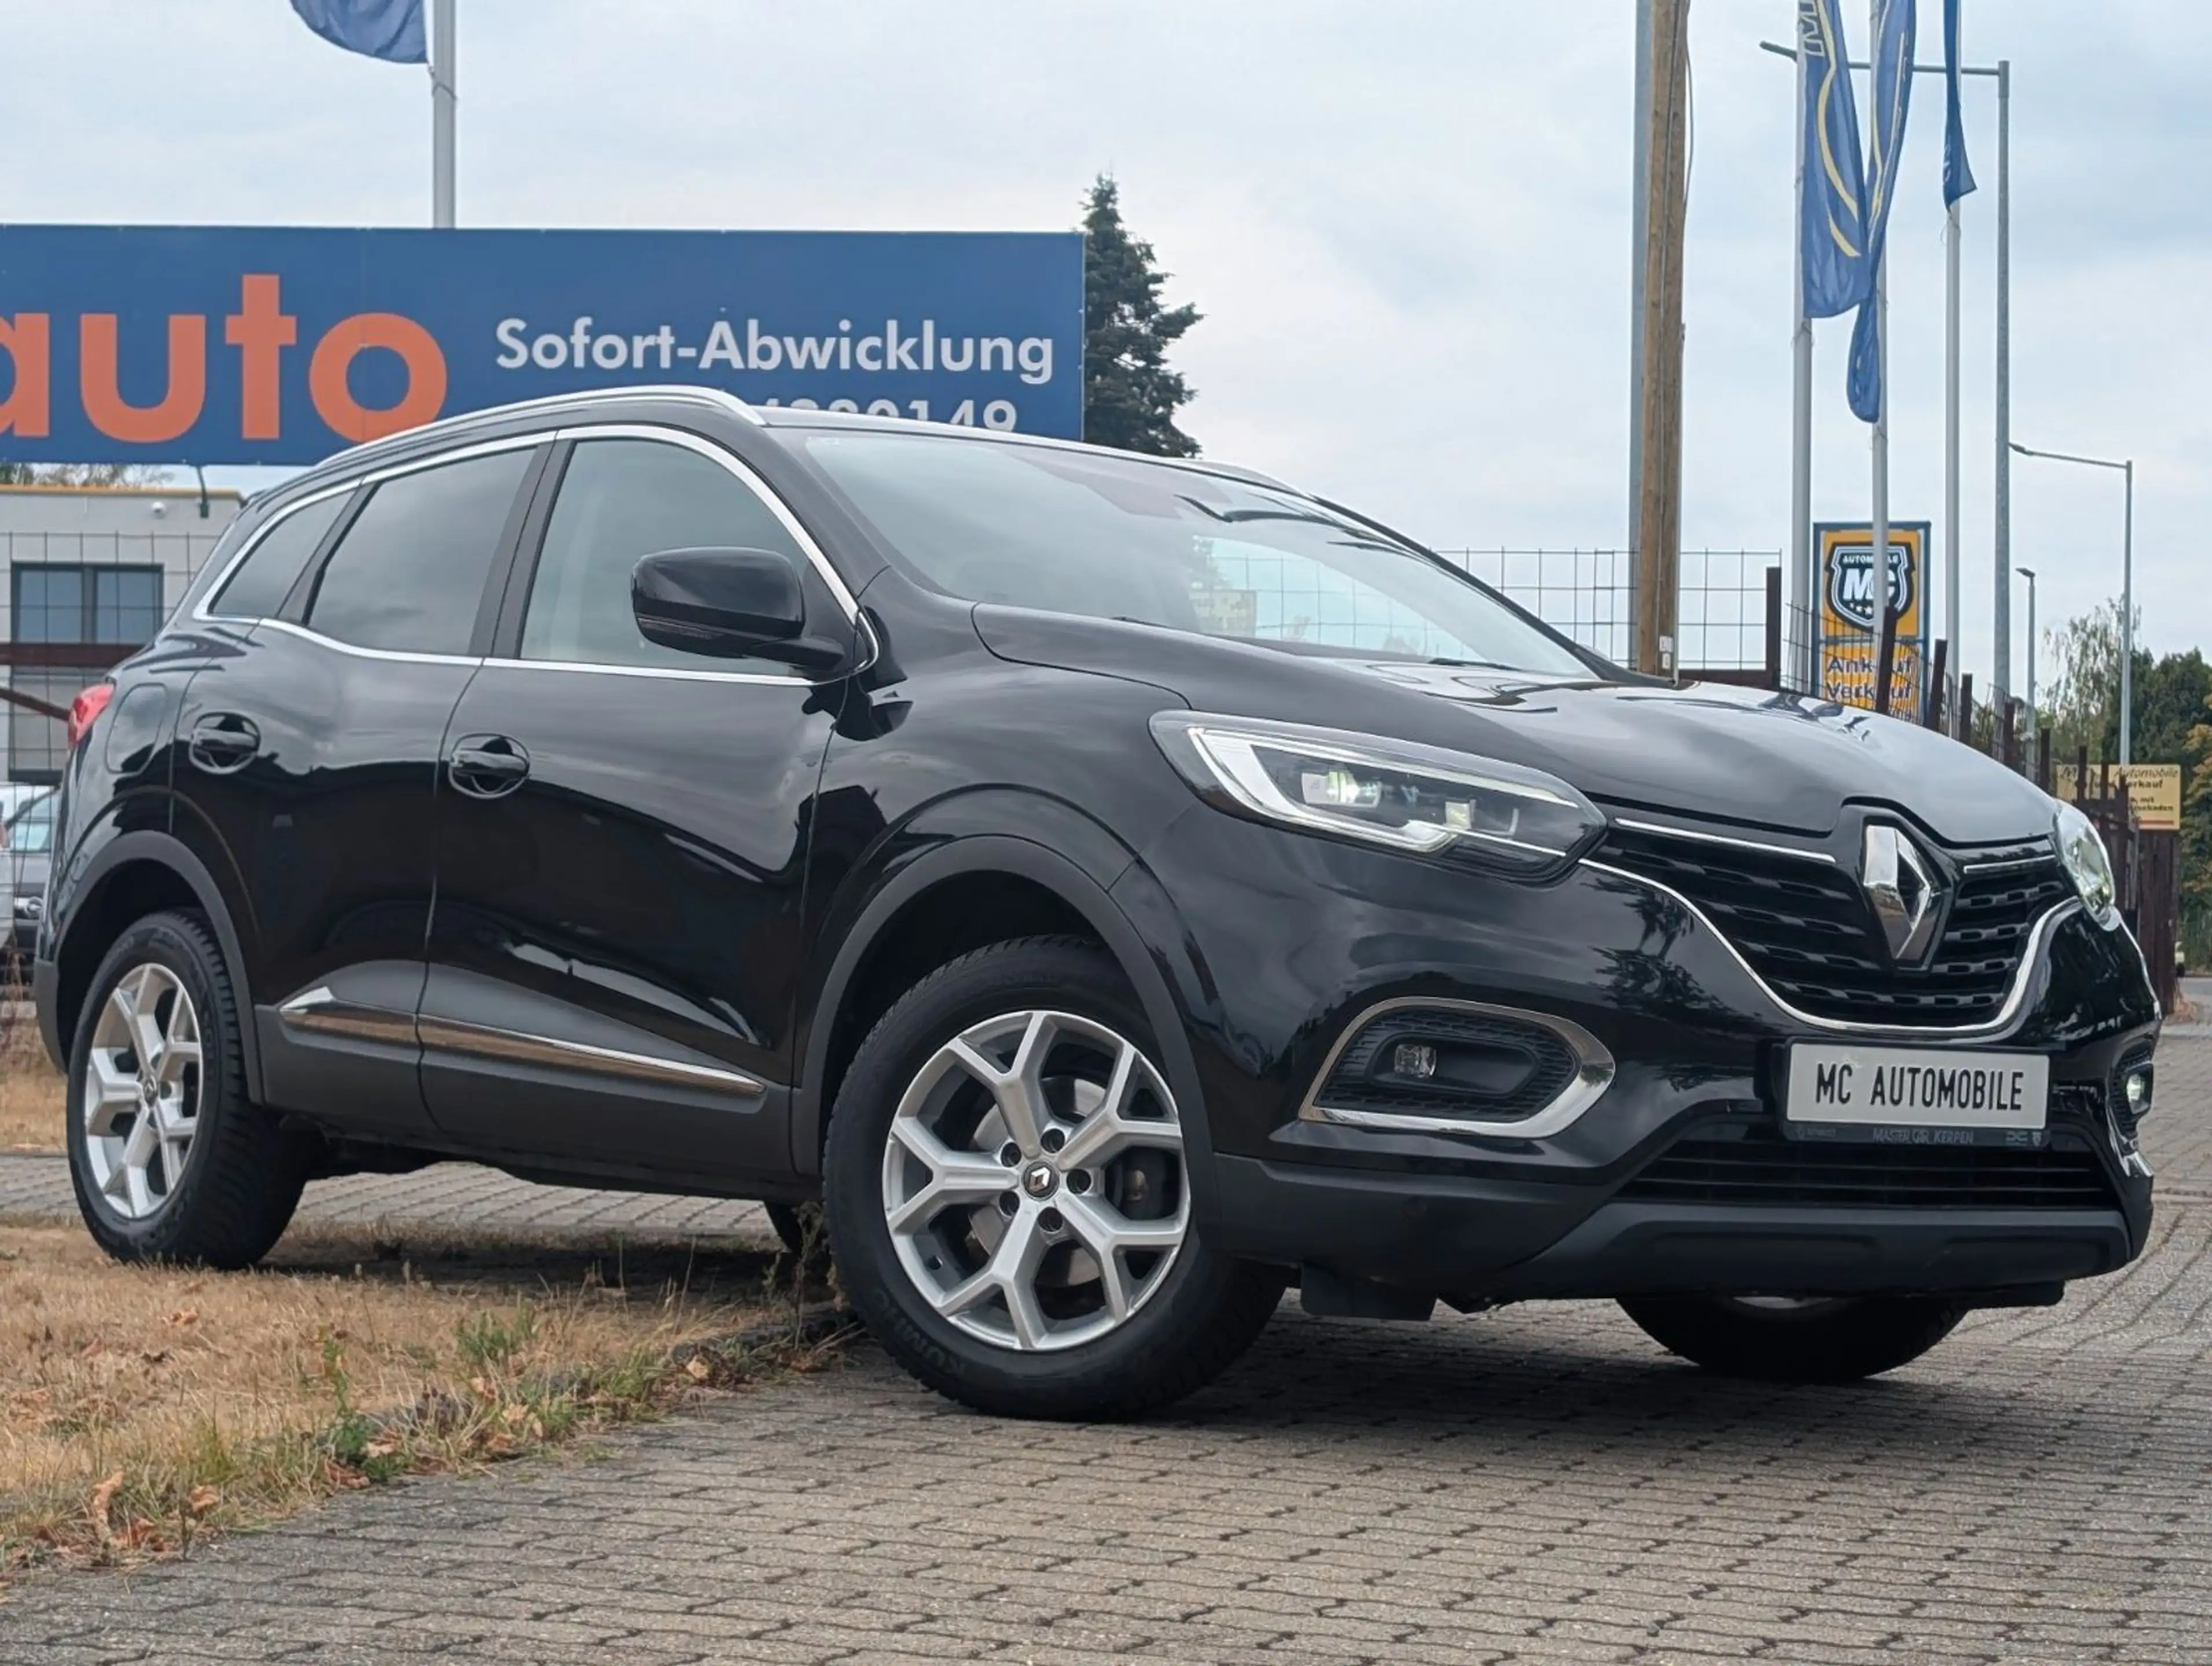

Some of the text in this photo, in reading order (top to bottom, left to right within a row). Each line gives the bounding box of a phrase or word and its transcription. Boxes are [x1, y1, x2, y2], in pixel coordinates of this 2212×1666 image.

[495, 318, 1054, 384] Sofort-Abwicklung
[1842, 555, 1898, 565] AUTOMLE
[1828, 656, 1912, 673] Ankuf
[1827, 681, 1911, 700] Verkuf
[1816, 1063, 2024, 1111] MC AUTOMOBILE
